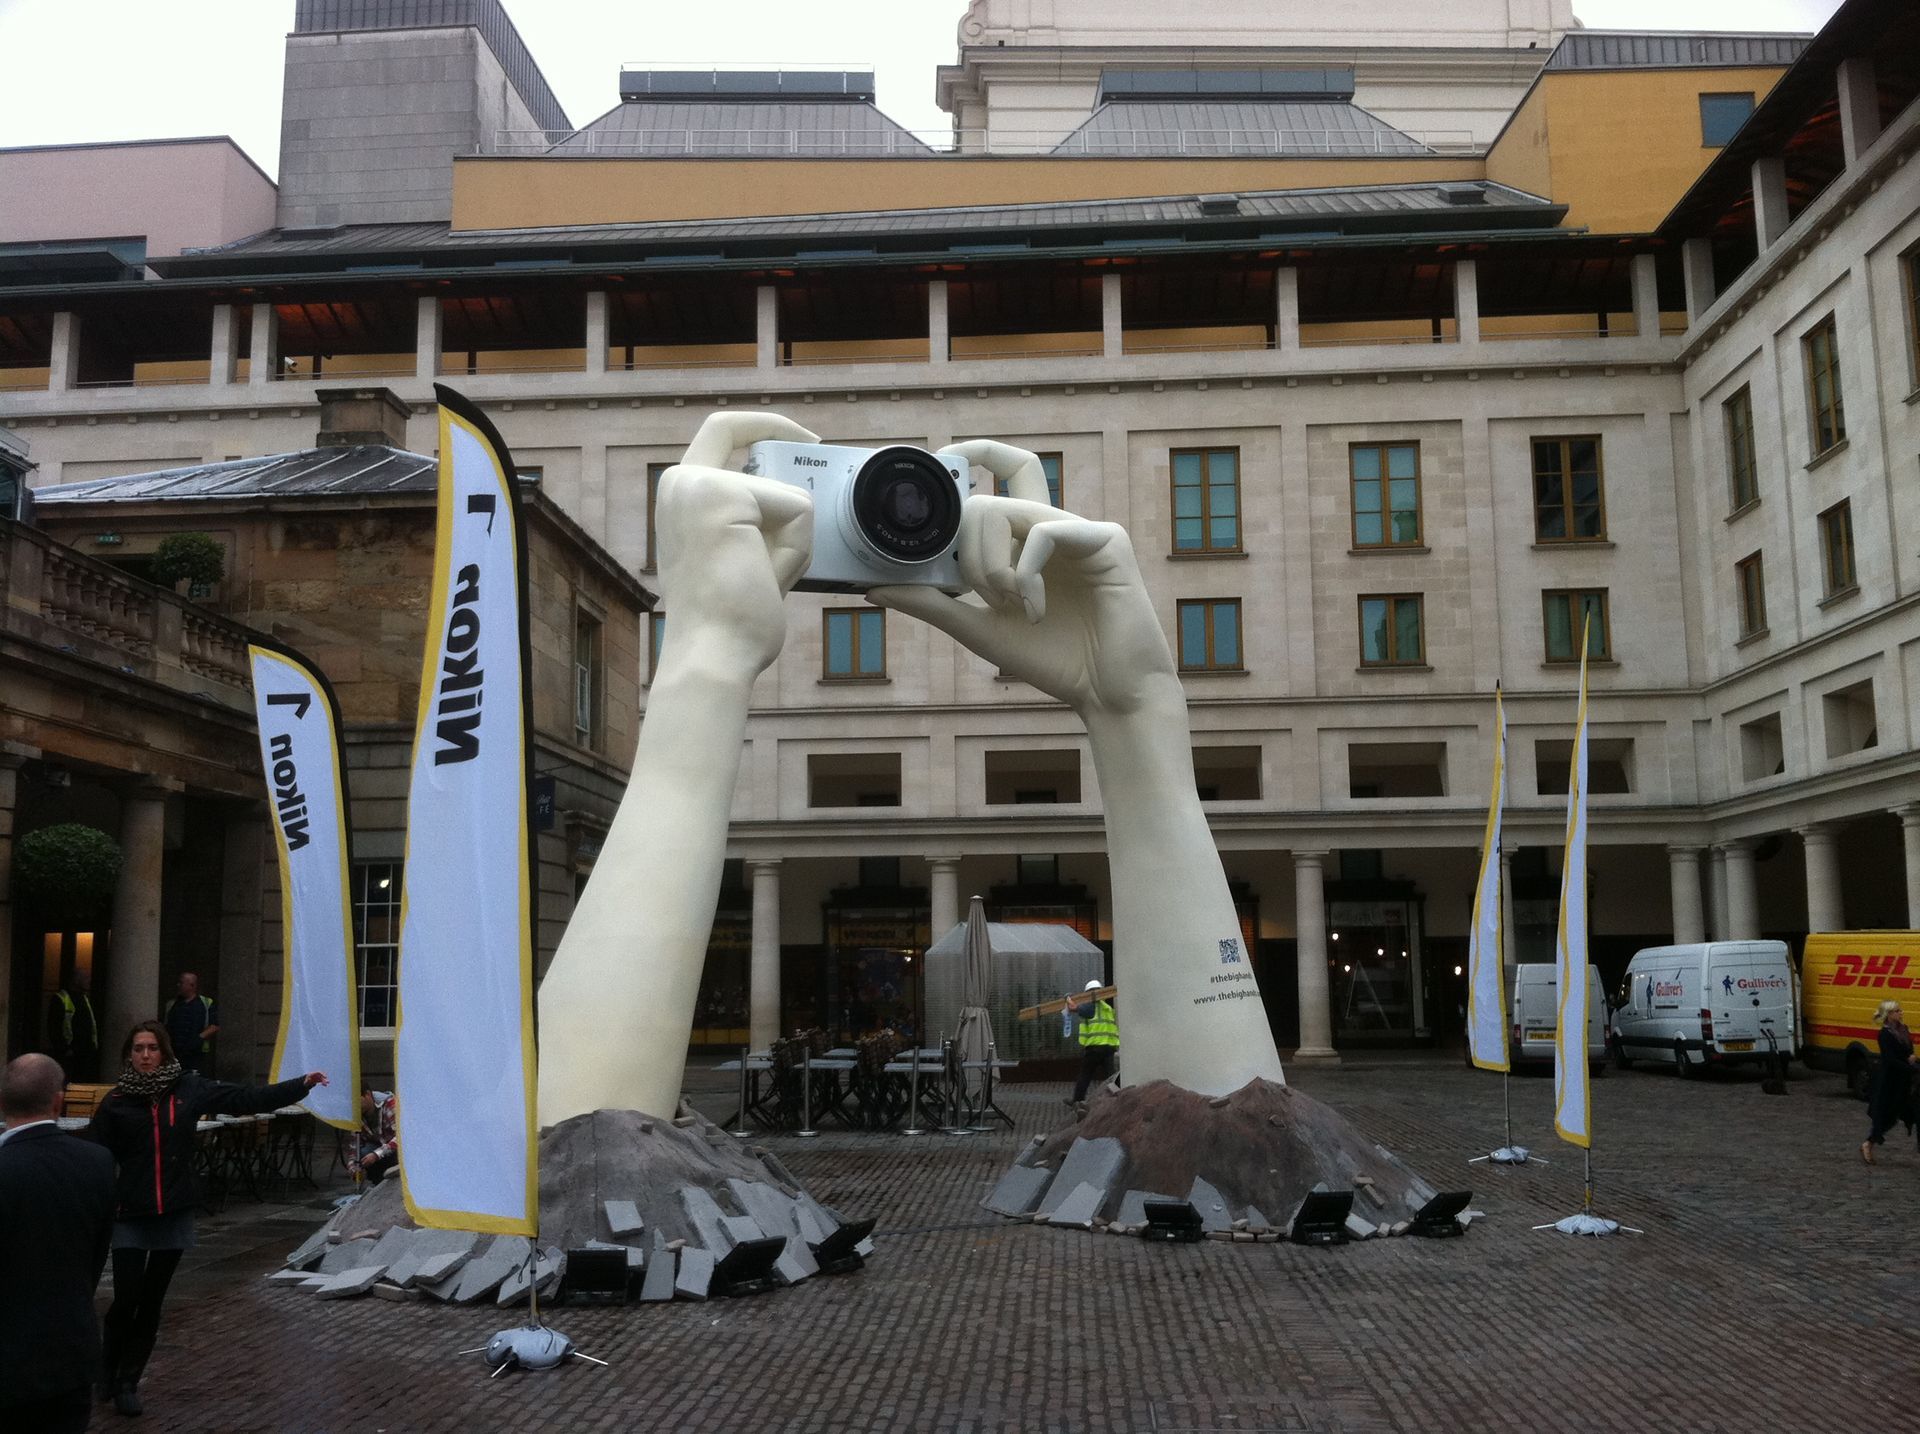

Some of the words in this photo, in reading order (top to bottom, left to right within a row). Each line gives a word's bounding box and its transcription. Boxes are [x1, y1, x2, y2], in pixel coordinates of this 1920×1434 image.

[794, 455, 828, 468] Nikon
[807, 476, 814, 490] 1
[1831, 953, 1915, 990] DHL
[1655, 981, 1683, 997] Gulliver's
[1737, 977, 1788, 992] Gulliver's
